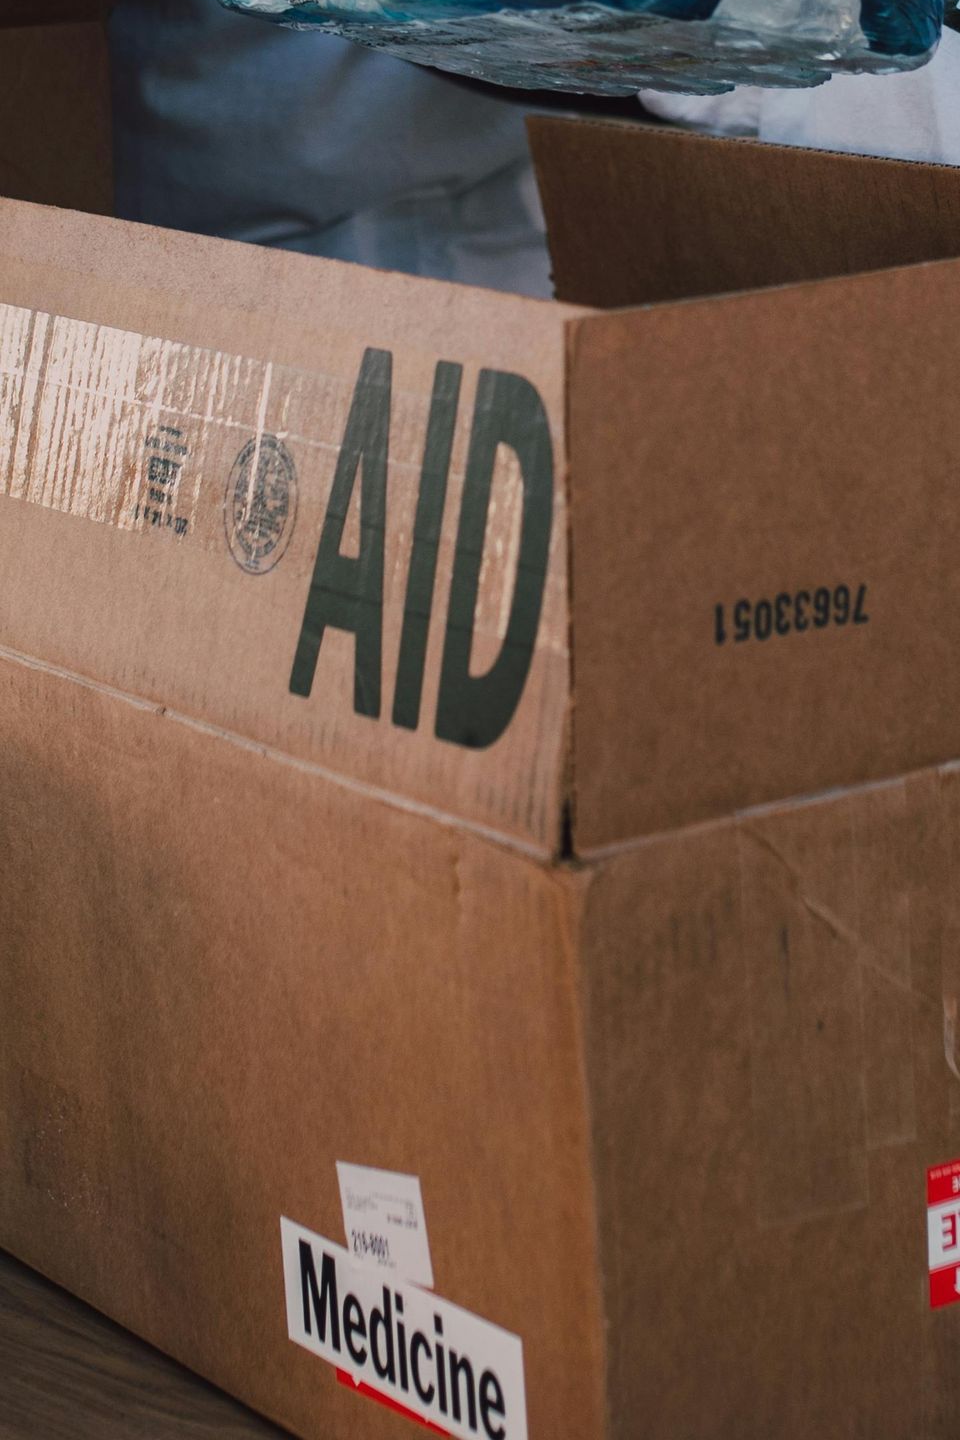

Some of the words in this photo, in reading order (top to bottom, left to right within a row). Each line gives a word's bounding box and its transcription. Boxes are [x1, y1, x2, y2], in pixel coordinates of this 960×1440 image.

[289, 347, 556, 753] AID
[714, 583, 870, 648] 76633051
[298, 1237, 507, 1440] Medicine
